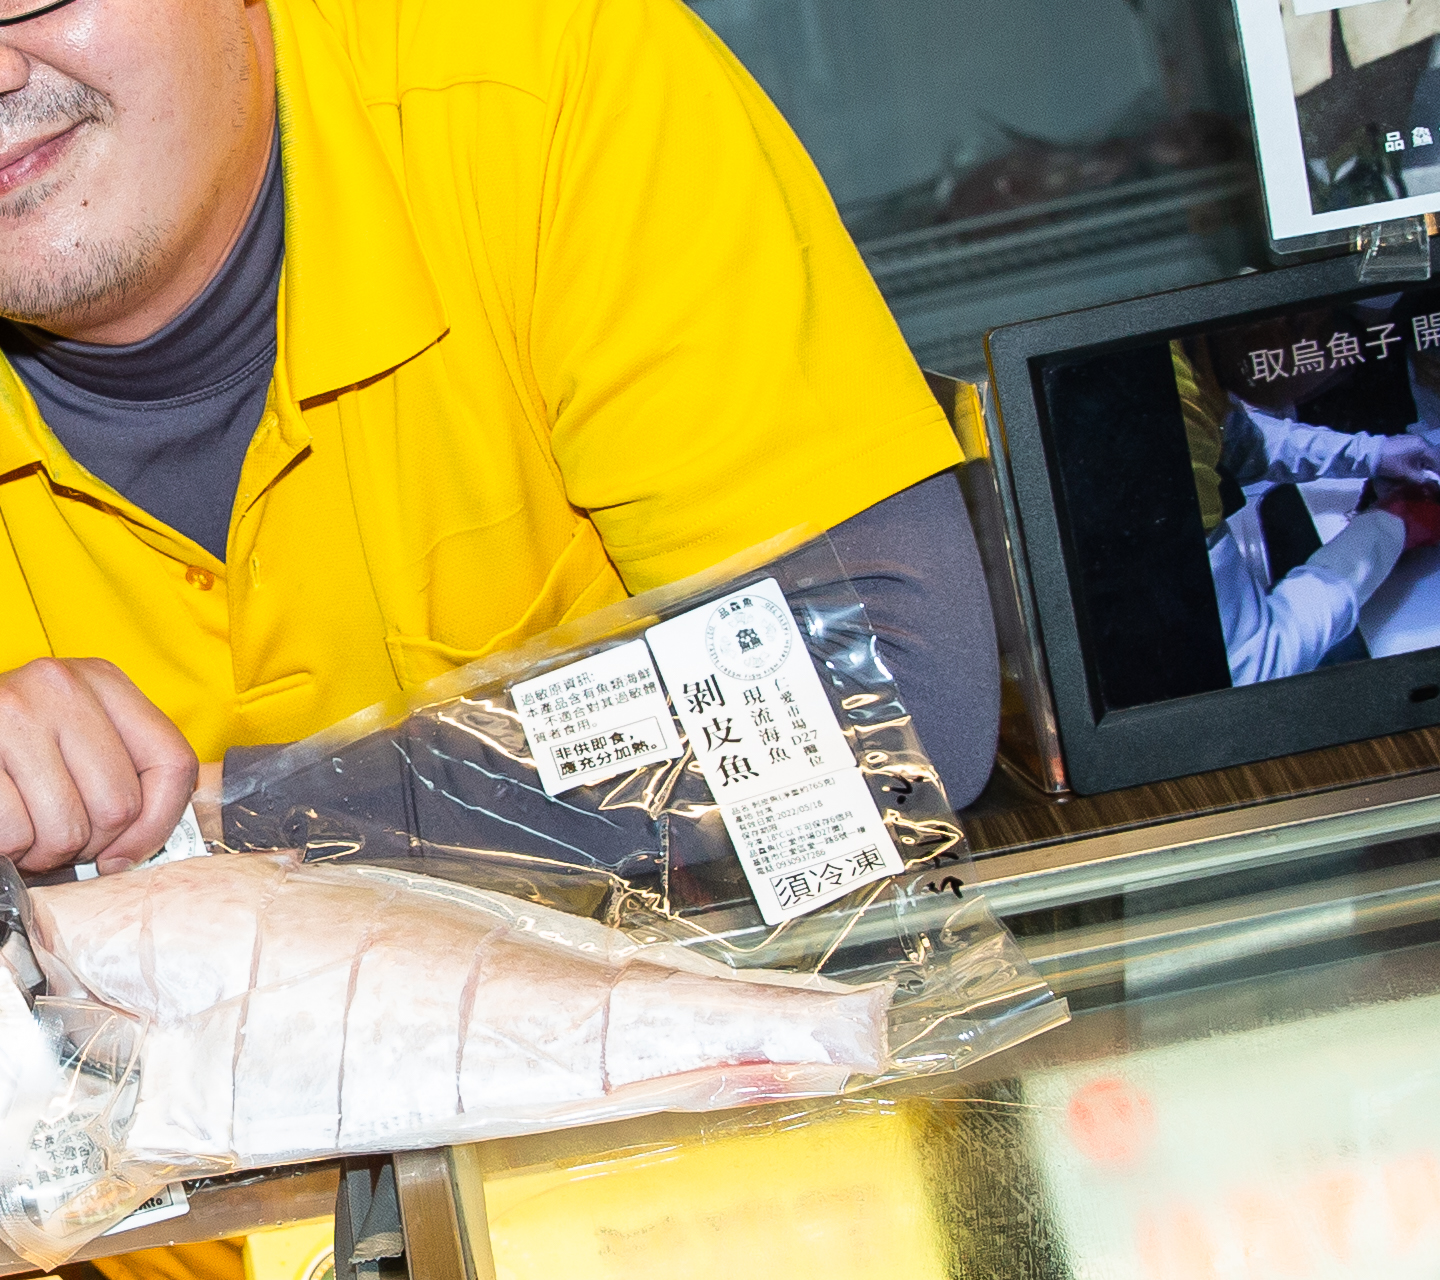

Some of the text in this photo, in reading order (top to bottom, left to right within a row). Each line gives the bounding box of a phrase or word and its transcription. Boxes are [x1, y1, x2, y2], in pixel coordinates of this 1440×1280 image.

[1248, 321, 1403, 386] 取烏魚子
[682, 674, 760, 787] 剝皮魚
[775, 847, 885, 907] 須冷凍
